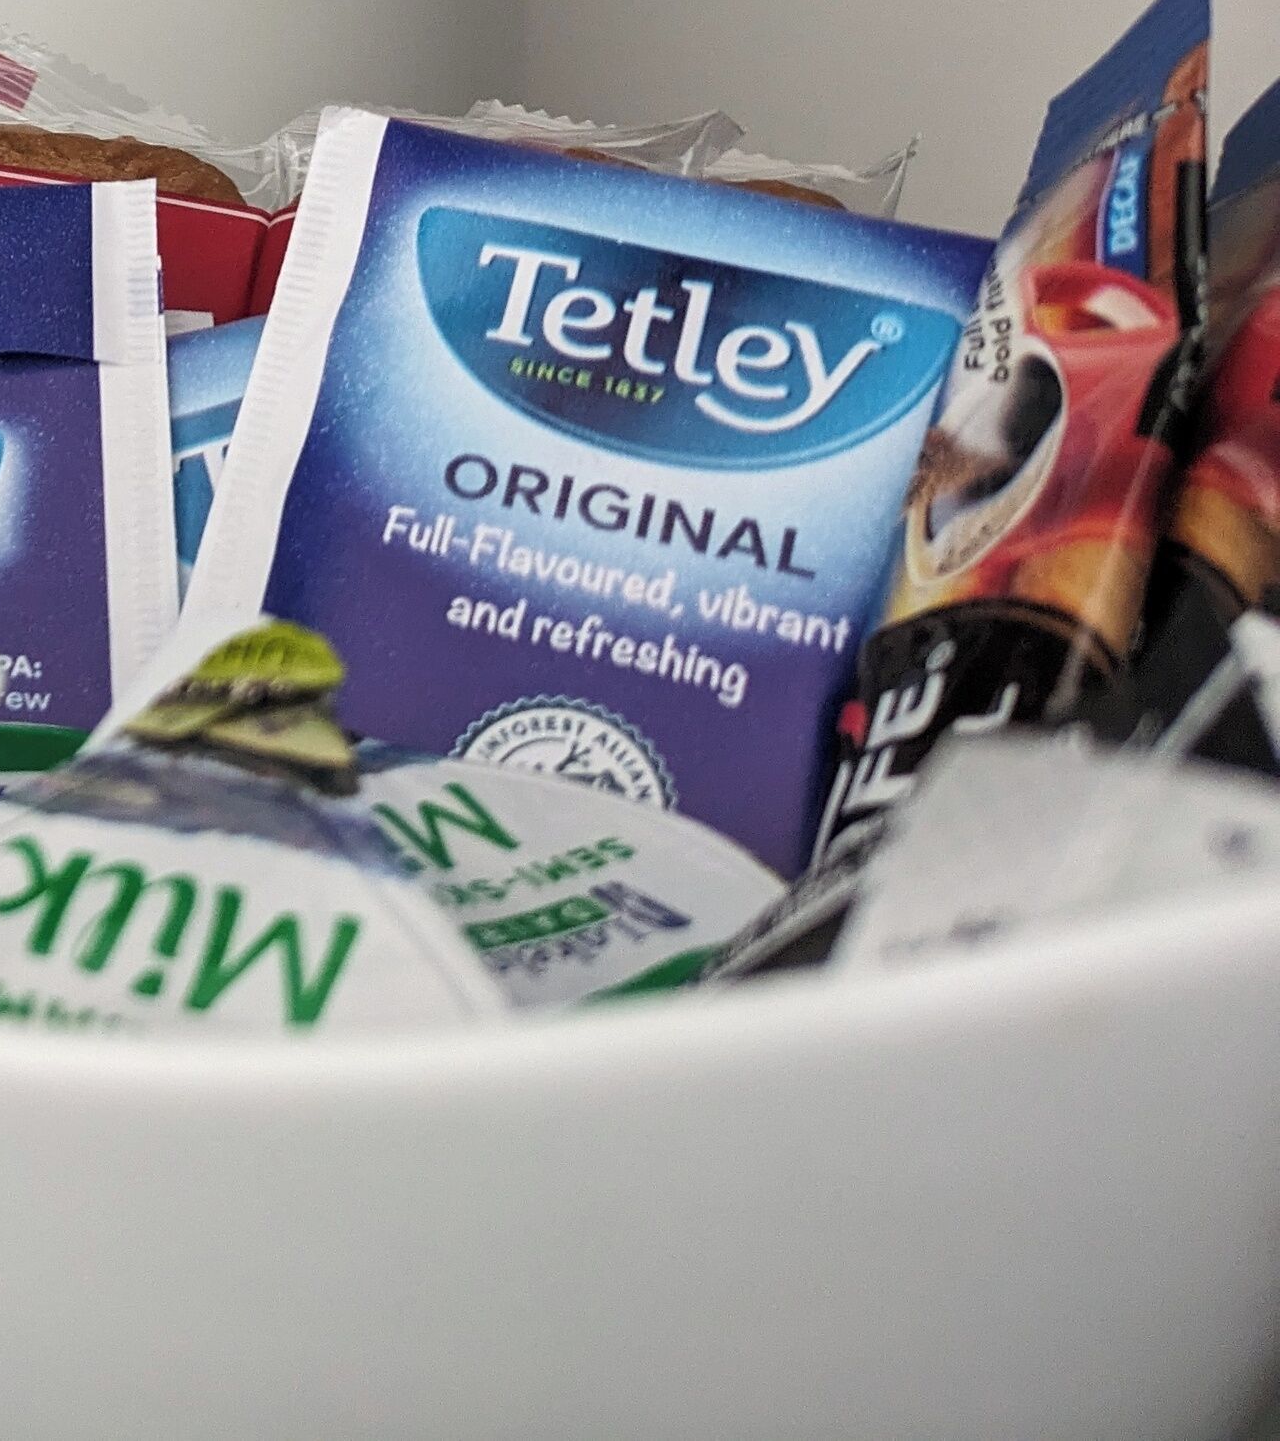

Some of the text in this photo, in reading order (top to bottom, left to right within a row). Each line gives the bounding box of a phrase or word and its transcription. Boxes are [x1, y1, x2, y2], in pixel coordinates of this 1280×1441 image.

[478, 240, 886, 435] Tetley
[509, 356, 593, 391] SINCE
[987, 315, 1012, 383] bold
[443, 451, 820, 581] ORIGINAL
[382, 504, 853, 654] Full-Flavoured, vibrant
[446, 592, 751, 708] and refreshing
